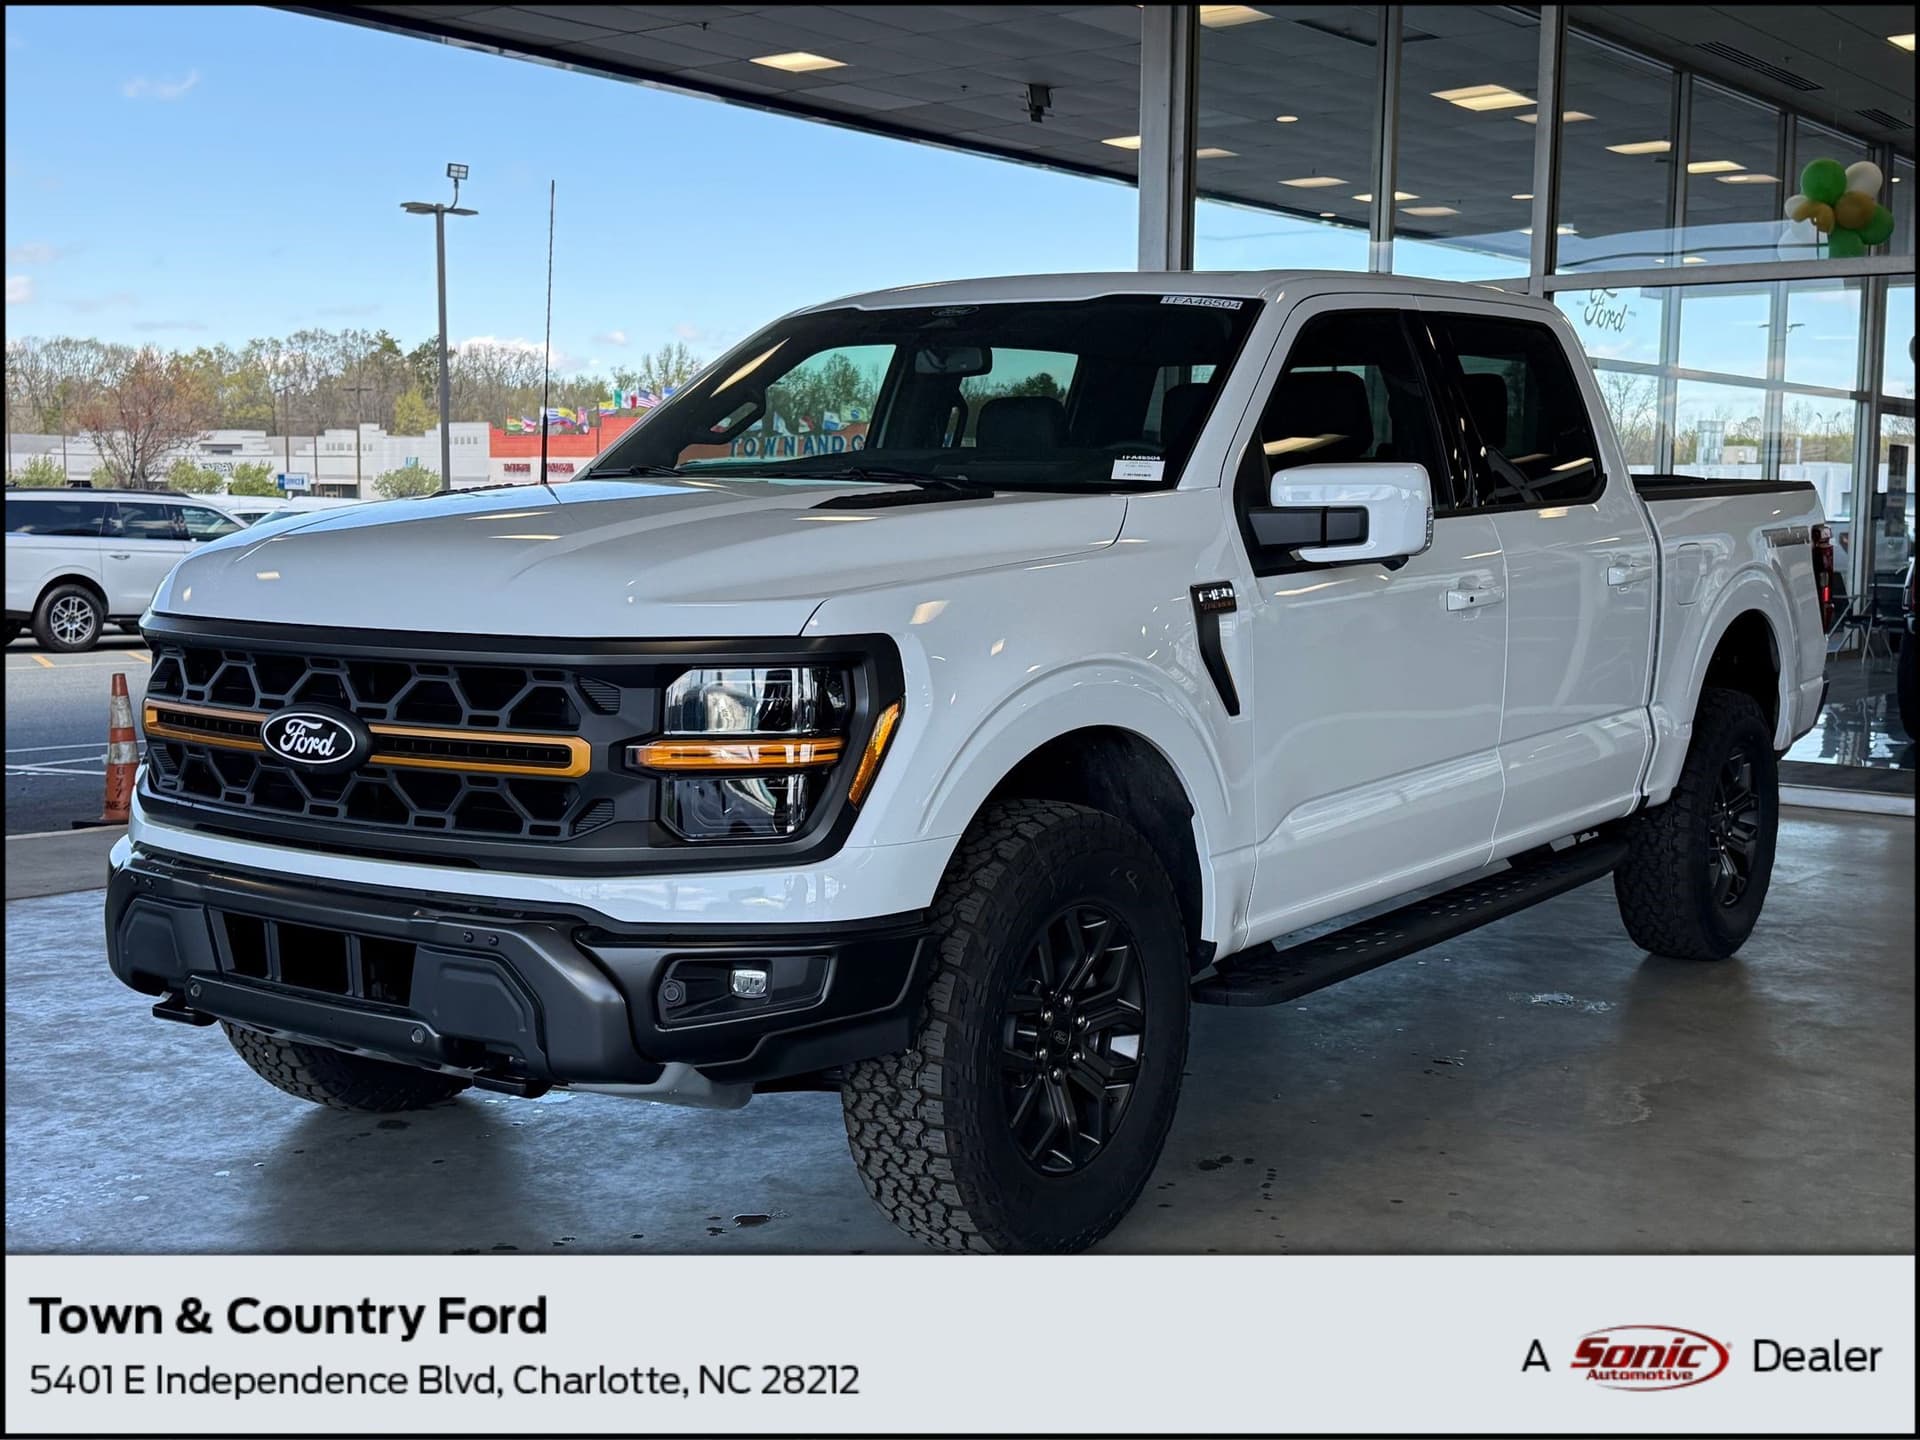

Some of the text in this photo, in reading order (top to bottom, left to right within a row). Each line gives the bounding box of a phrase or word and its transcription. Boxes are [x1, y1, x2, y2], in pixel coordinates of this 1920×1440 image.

[1584, 287, 1628, 333] Ford
[731, 435, 799, 457] TOWN
[280, 718, 337, 757] Ford
